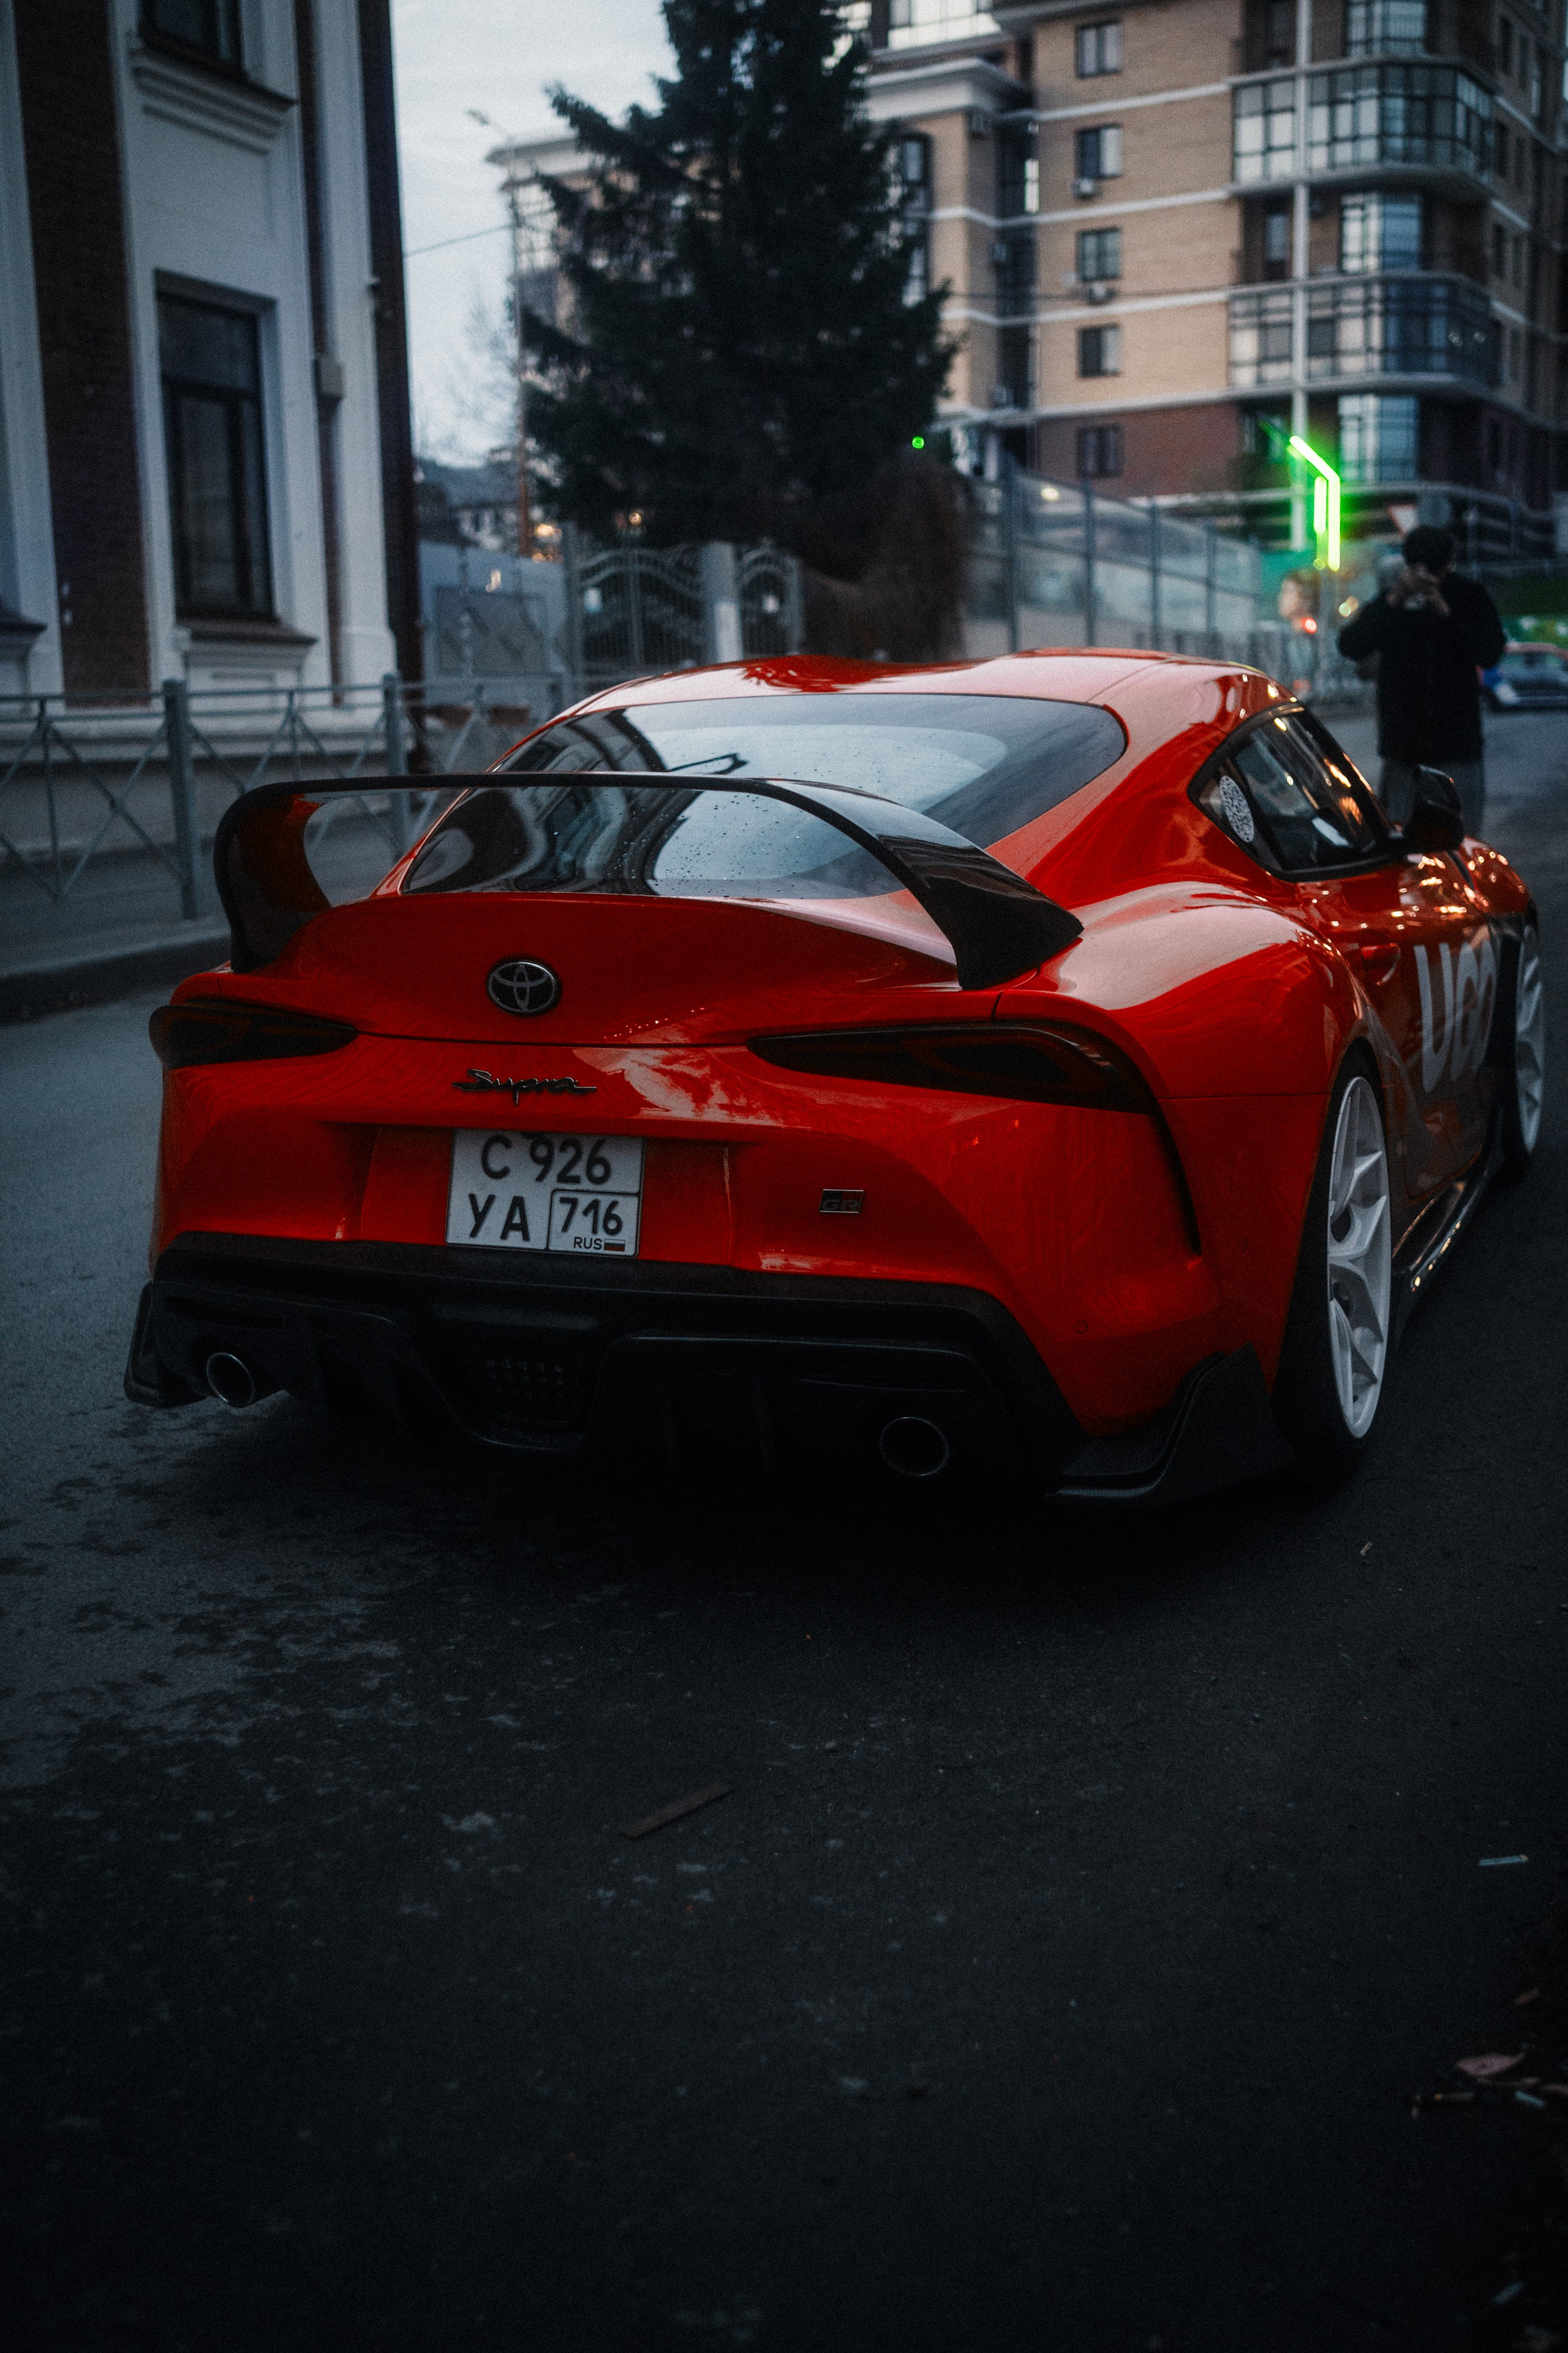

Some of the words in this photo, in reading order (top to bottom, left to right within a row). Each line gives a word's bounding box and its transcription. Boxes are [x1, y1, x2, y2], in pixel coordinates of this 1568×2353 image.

[451, 1068, 597, 1105] Supra
[530, 1136, 611, 1185] 926
[559, 1197, 623, 1236] 716
[821, 1199, 859, 1212] GR
[573, 1236, 603, 1250] RUS
